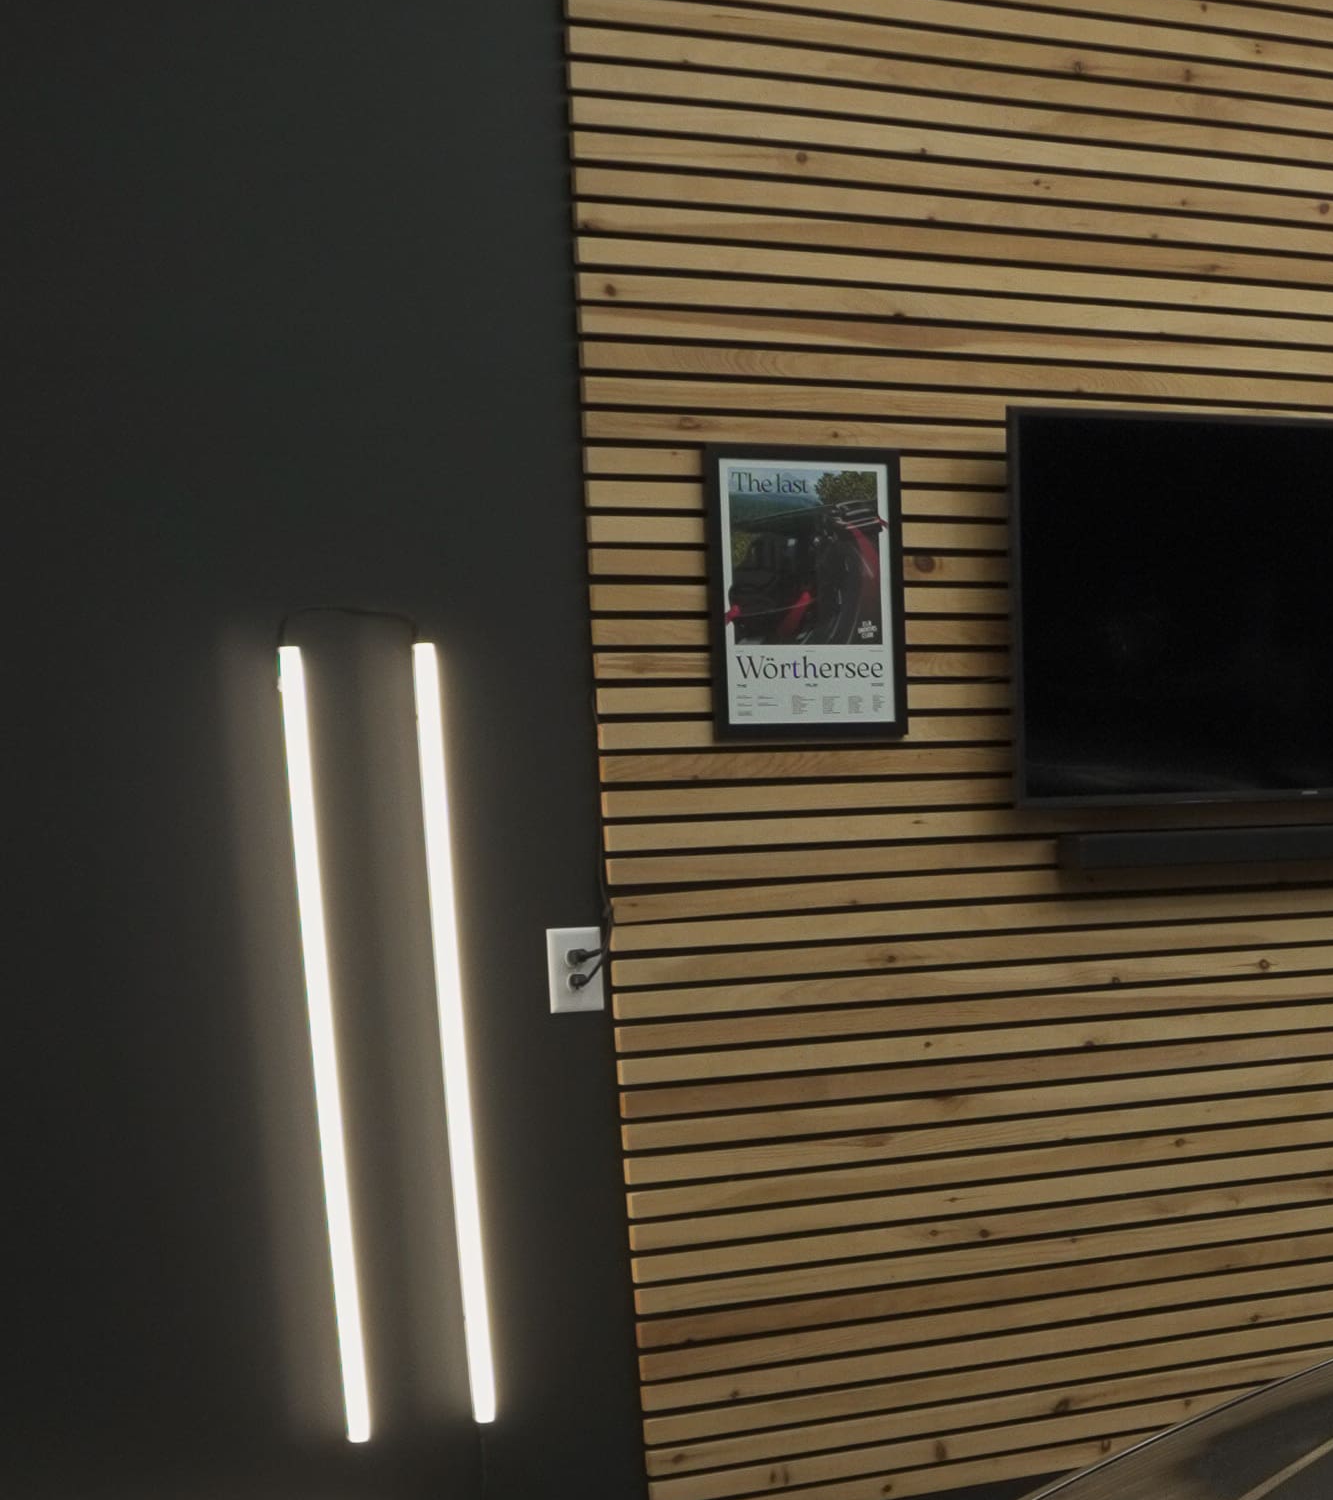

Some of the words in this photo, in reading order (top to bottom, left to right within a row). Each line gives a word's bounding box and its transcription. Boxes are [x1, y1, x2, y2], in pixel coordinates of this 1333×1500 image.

[732, 472, 773, 493] The
[776, 473, 809, 494] last
[736, 655, 883, 679] Wörthersee
